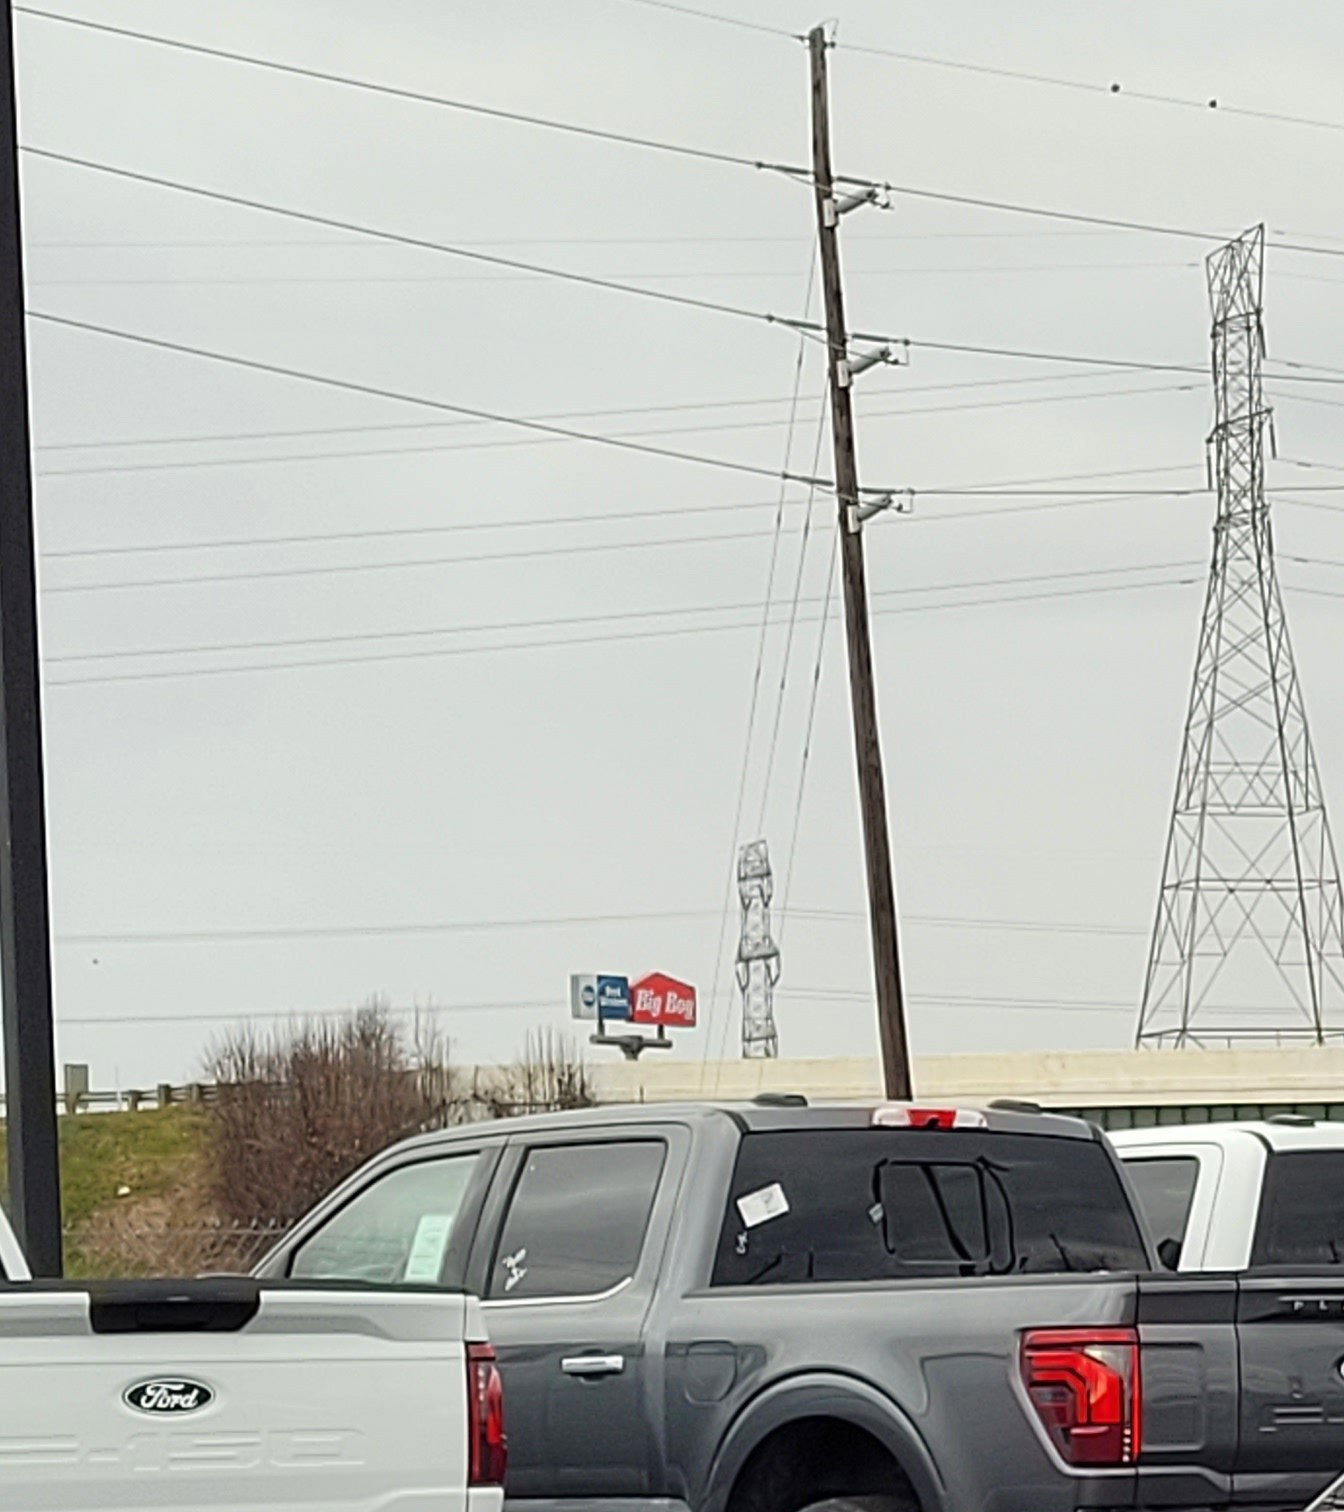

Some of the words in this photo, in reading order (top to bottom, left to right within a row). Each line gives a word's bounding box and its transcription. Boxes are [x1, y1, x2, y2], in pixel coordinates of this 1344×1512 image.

[636, 988, 661, 1017] Big
[665, 990, 694, 1019] Boy
[139, 1383, 200, 1409] Ford
